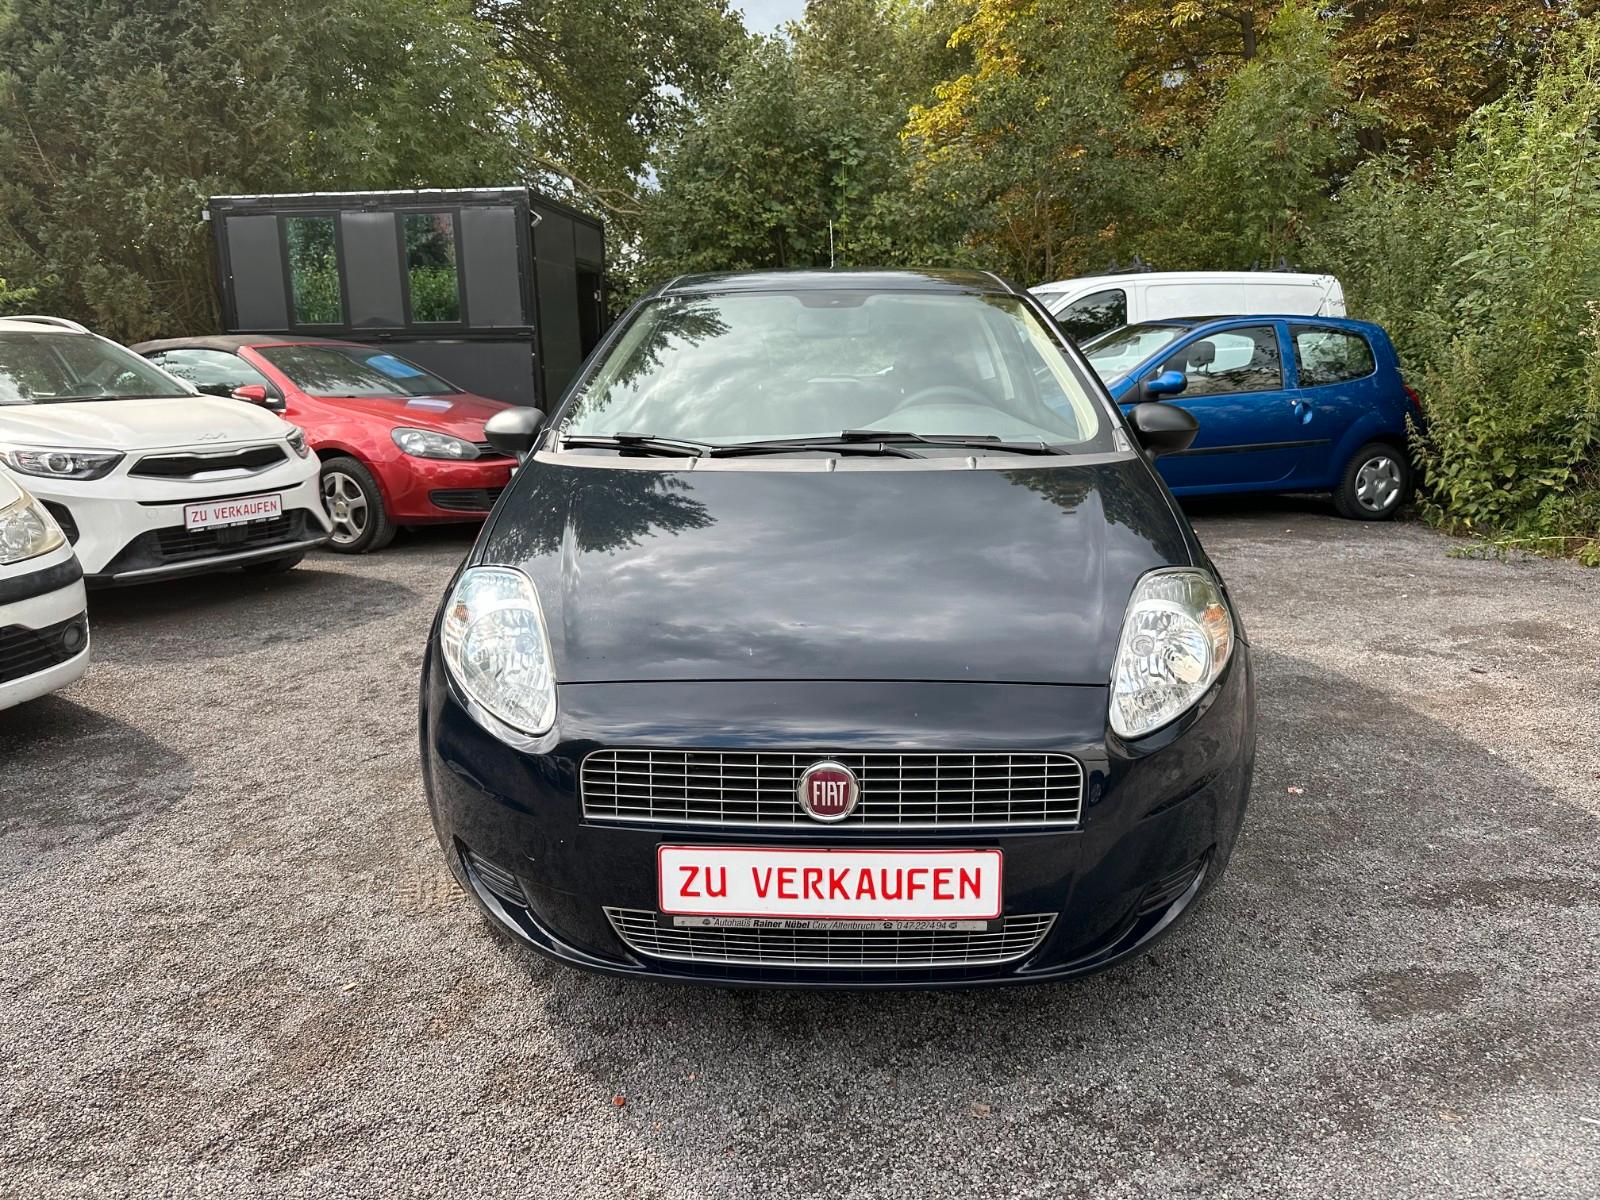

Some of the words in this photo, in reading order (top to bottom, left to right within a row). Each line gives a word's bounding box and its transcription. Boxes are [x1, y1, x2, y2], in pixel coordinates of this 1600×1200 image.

[191, 510, 208, 523] ZU
[213, 500, 277, 520] VERKAUFEN
[812, 781, 847, 807] FIAT
[678, 865, 727, 898] ZU
[752, 866, 981, 900] VERKAUFEN
[713, 918, 751, 928] Autohaus
[752, 919, 782, 929] Rainer
[784, 919, 810, 930] Nübel
